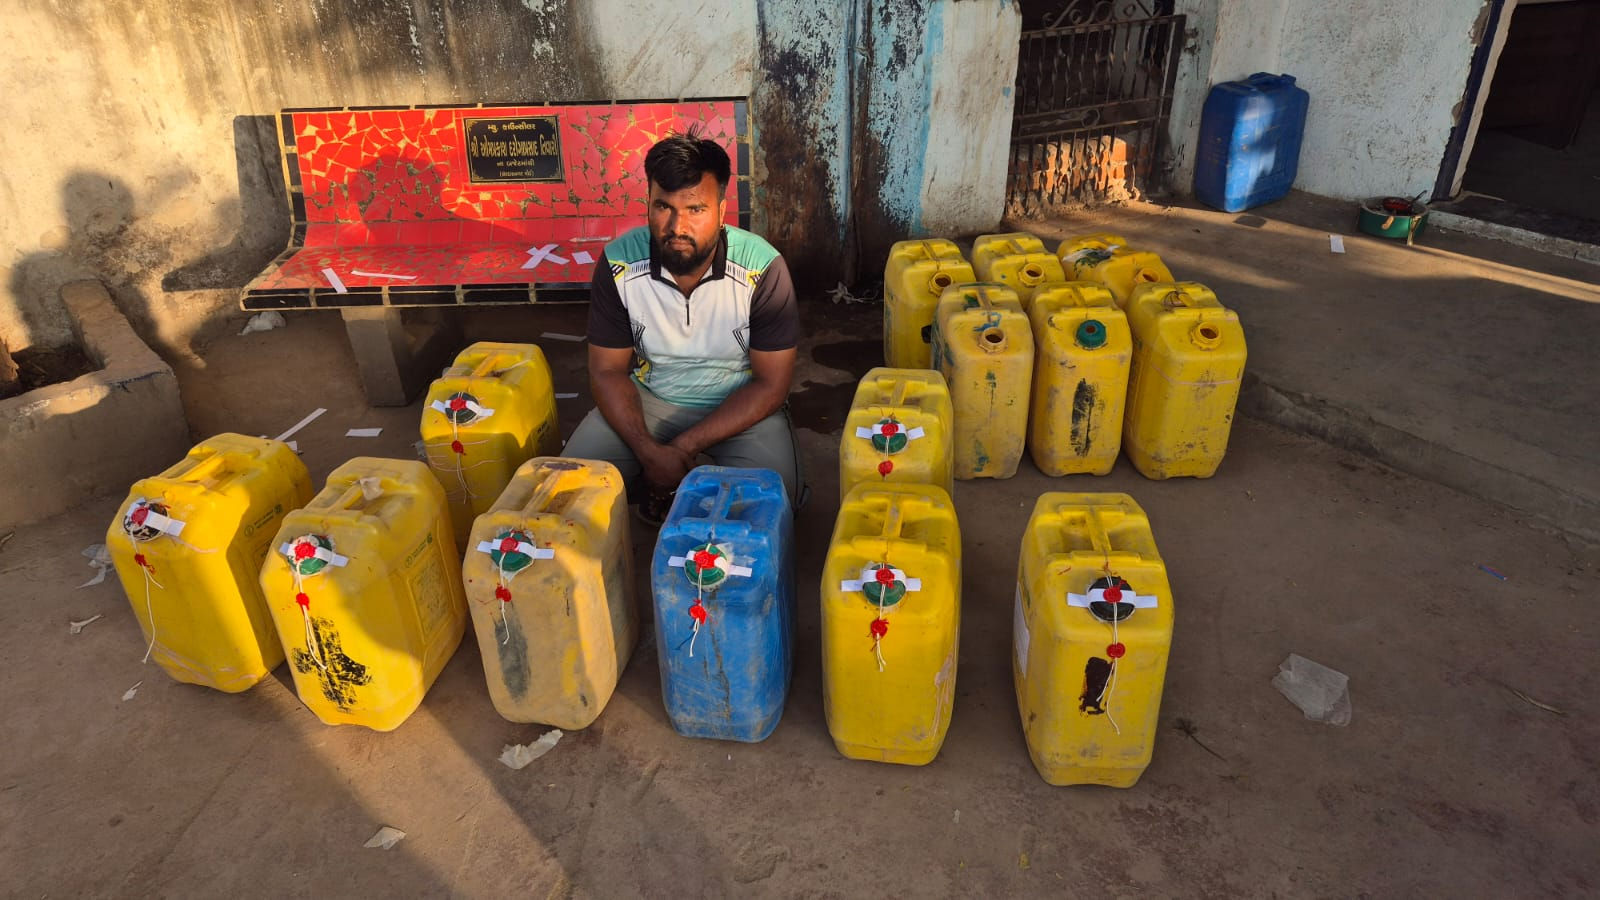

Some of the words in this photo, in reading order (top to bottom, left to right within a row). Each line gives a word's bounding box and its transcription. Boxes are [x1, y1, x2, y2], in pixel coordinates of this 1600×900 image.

[471, 136, 479, 157] શ્રી
[480, 135, 507, 157] ઓમપ્રકાશ
[540, 134, 558, 156] તિવારી
